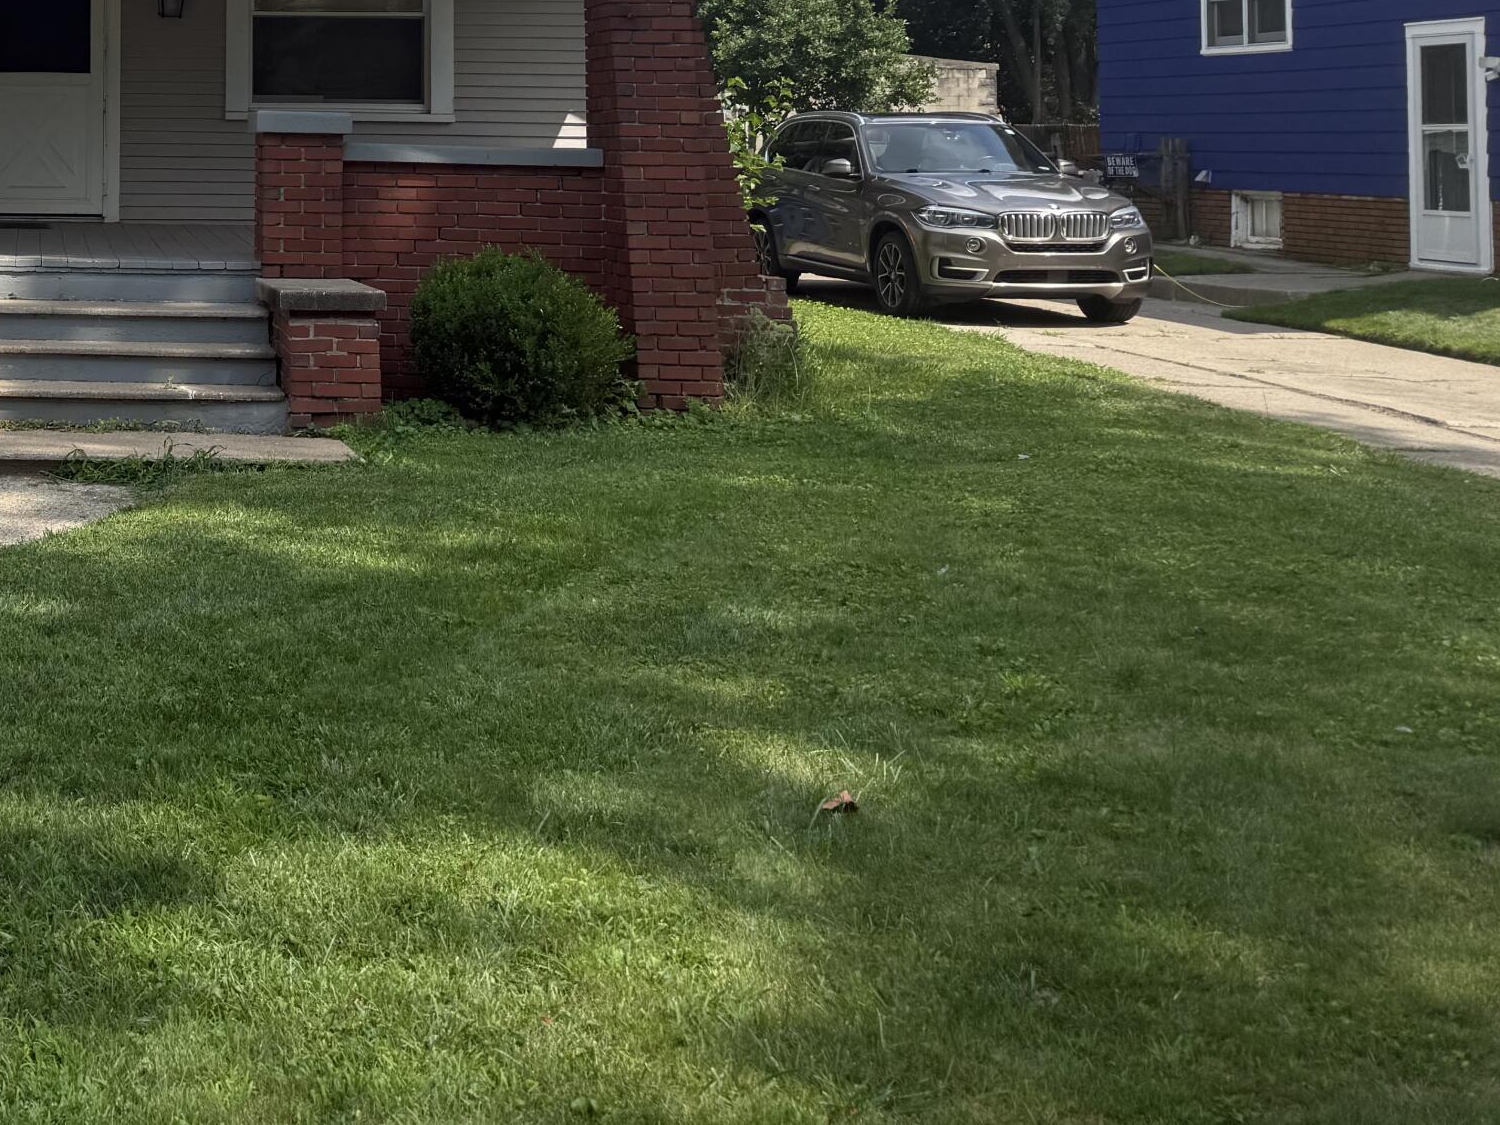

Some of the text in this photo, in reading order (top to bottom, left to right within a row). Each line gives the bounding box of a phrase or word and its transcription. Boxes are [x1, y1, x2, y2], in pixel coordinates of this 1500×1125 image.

[1106, 156, 1135, 166] BEWARE
[1107, 166, 1115, 175] OF
[1115, 166, 1125, 175] THE
